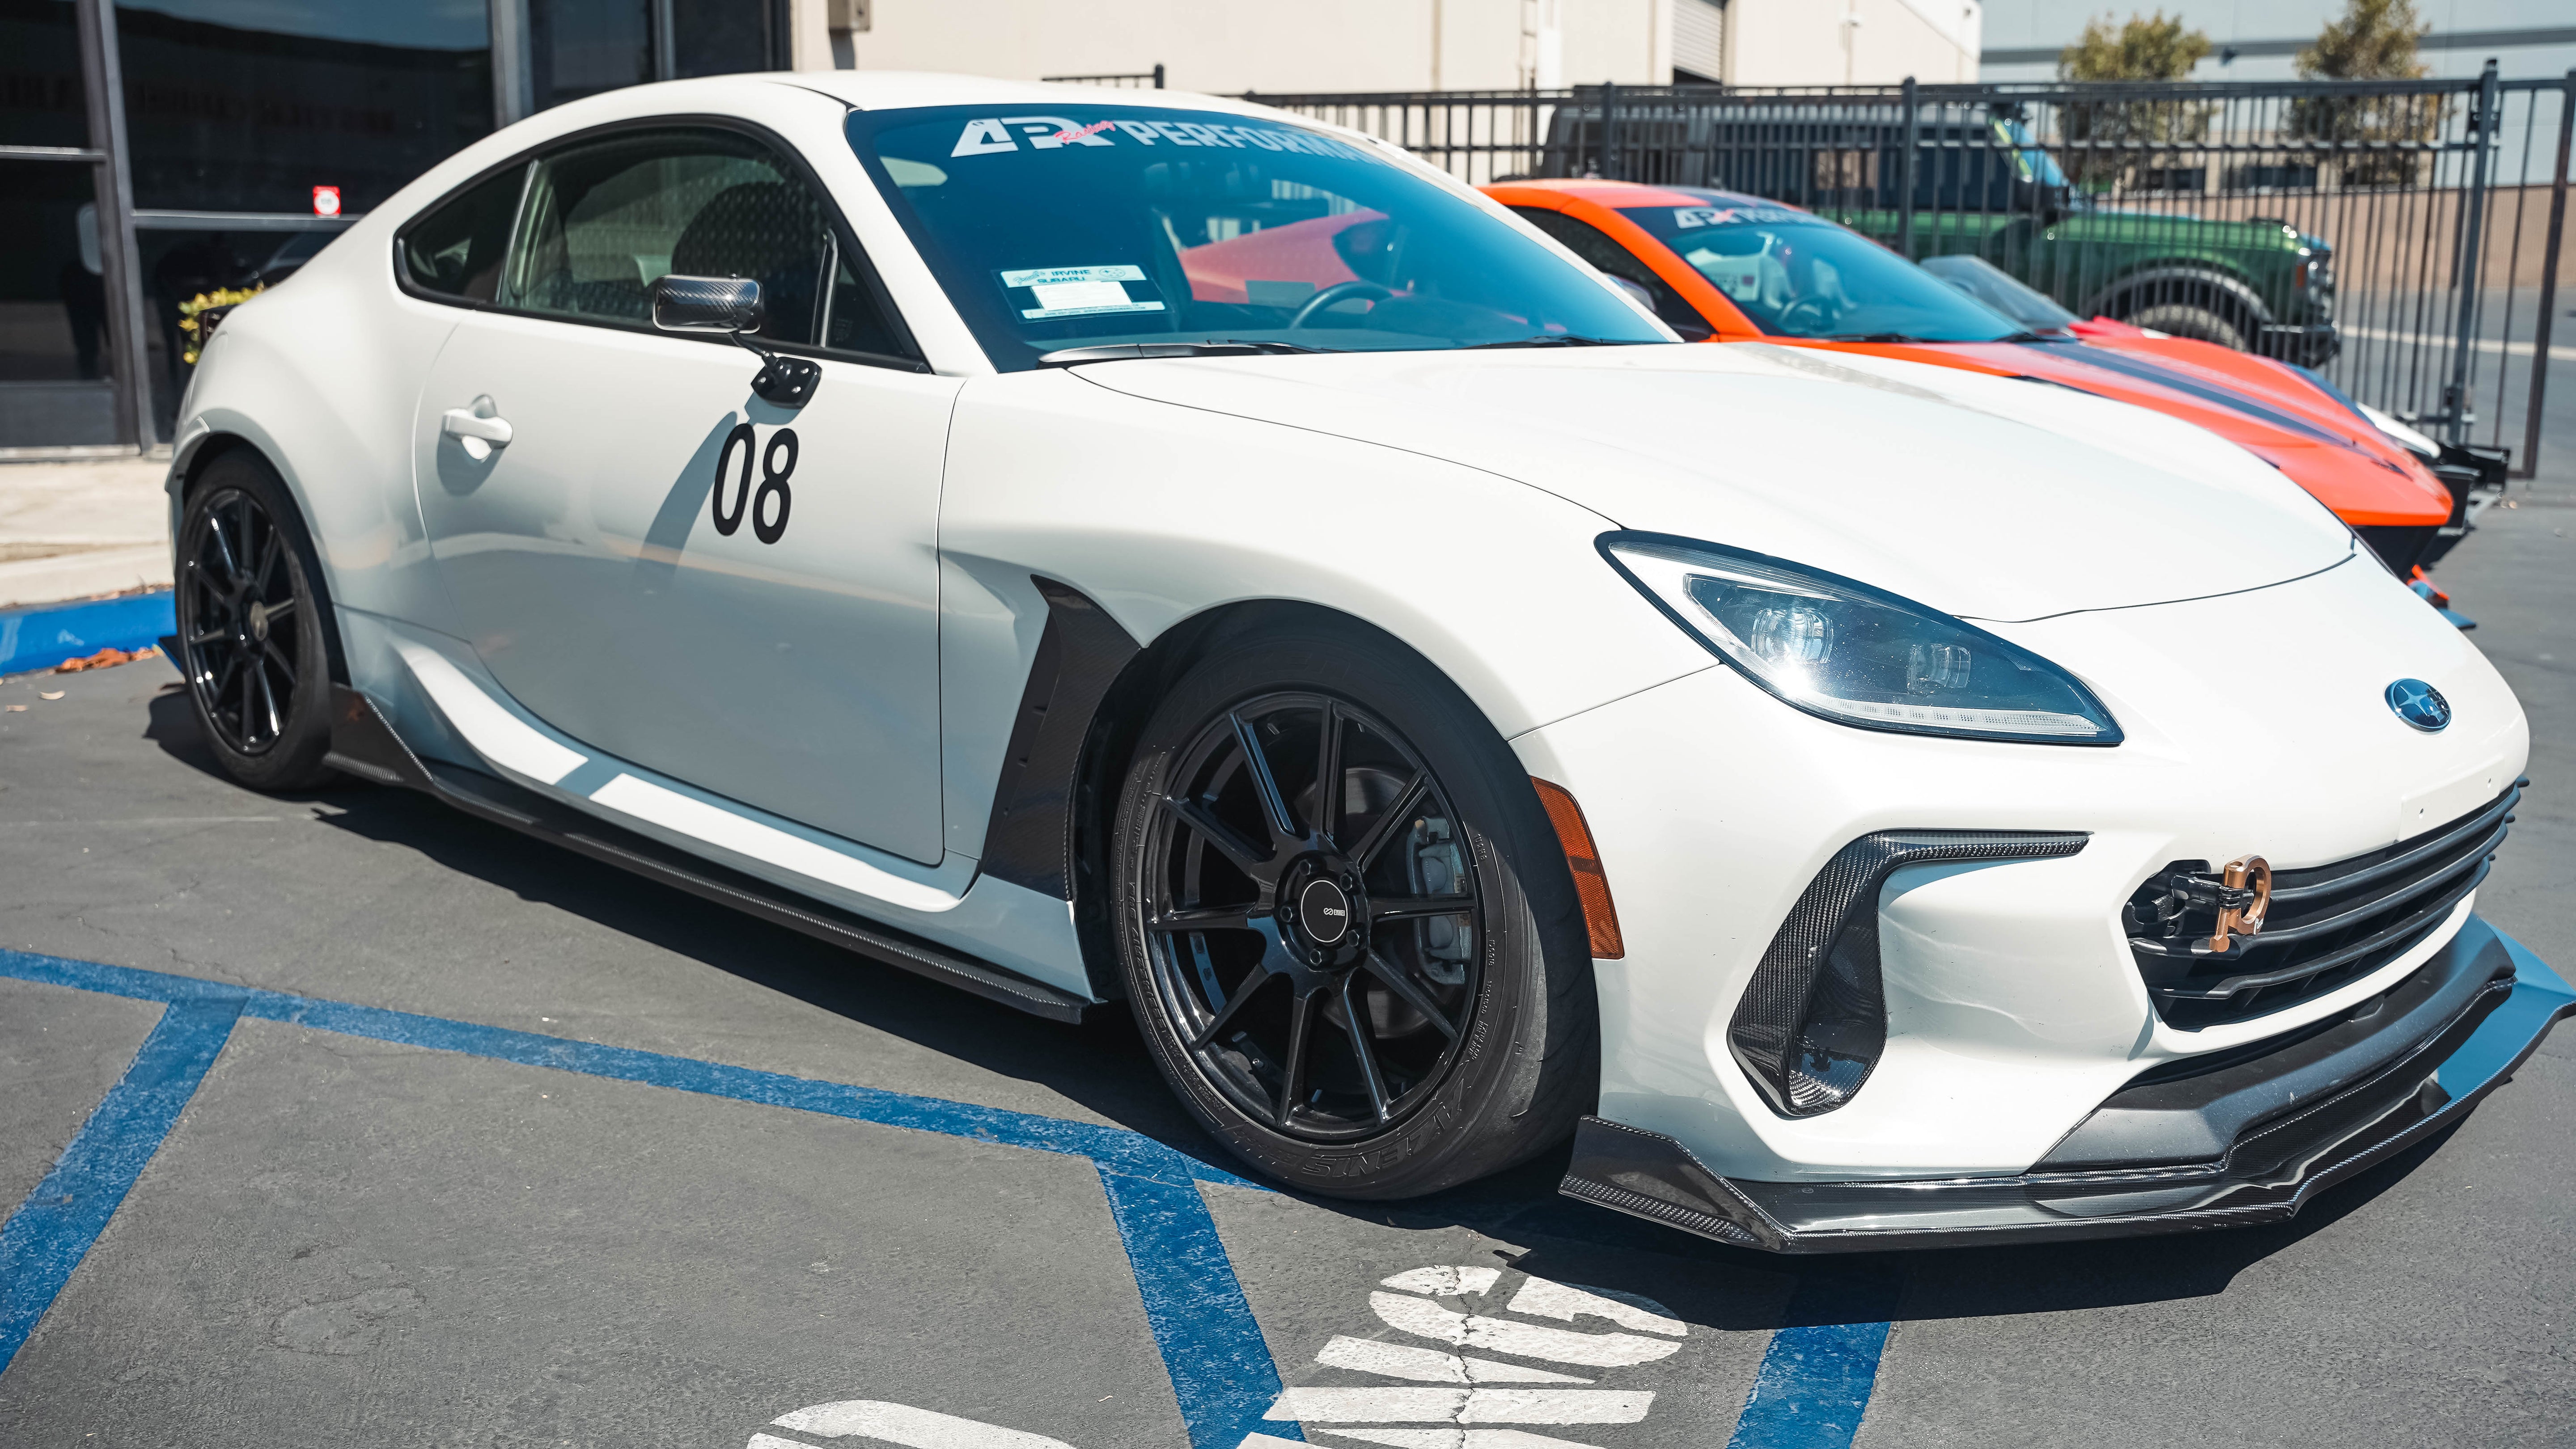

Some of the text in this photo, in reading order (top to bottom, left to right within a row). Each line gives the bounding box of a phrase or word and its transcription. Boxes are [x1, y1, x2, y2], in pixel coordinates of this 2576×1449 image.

[1054, 120, 1116, 145] Racing
[713, 423, 799, 544] 08
[1301, 1078, 1464, 1177] AZENIS
